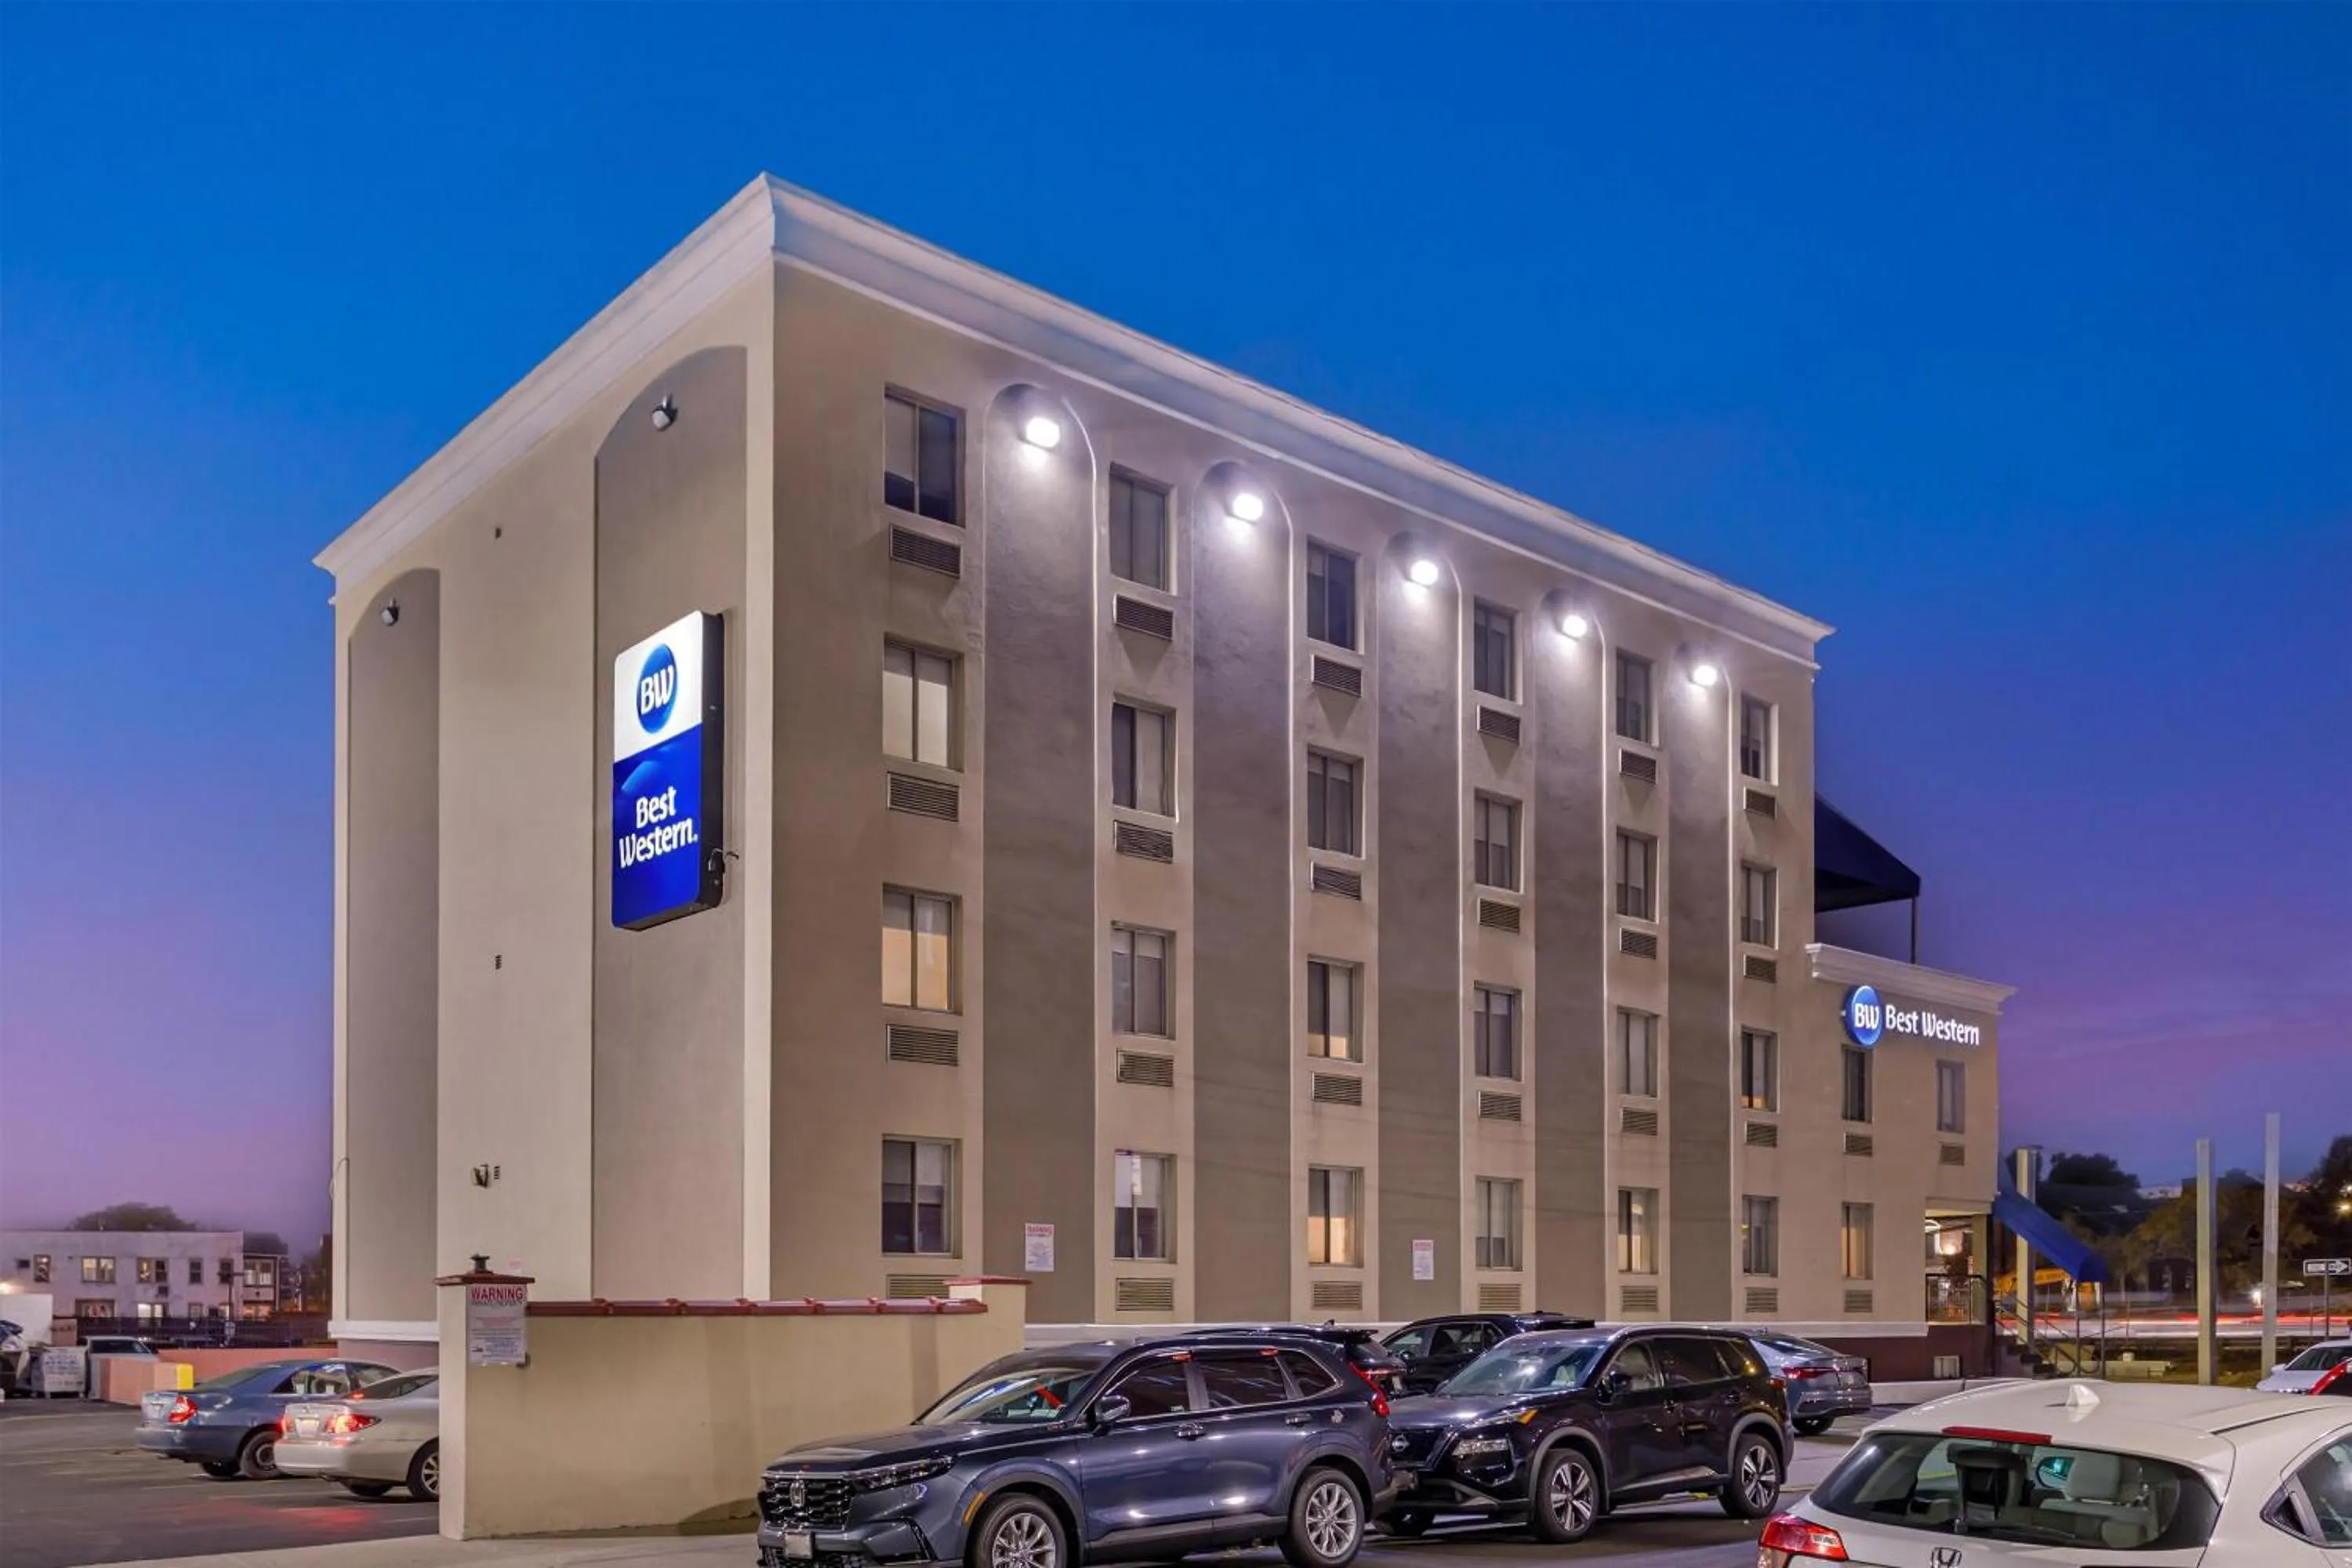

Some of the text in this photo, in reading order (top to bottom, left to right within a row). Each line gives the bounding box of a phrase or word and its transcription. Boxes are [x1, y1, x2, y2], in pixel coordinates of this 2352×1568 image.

[641, 665, 674, 714] BW
[636, 786, 677, 829] Best
[1854, 1003, 1879, 1029] BW
[1886, 1004, 1980, 1045] Best Western
[471, 1287, 523, 1300] WARNING
